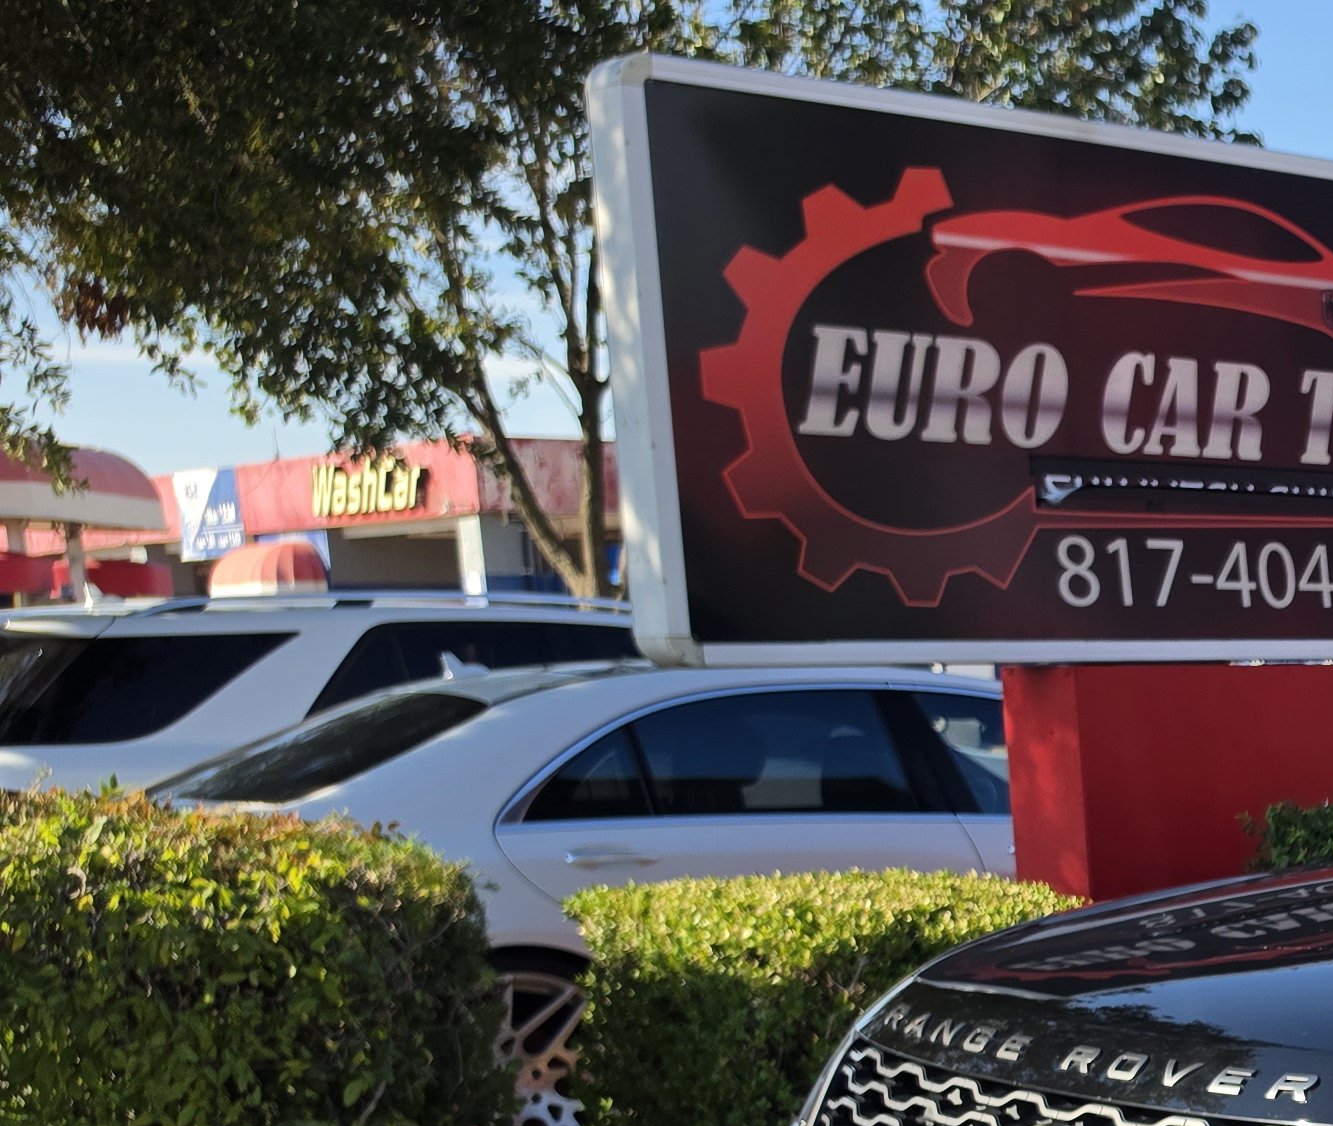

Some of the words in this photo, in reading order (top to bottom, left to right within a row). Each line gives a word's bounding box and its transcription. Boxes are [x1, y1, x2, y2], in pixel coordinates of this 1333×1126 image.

[800, 325, 1069, 449] EURO
[1101, 351, 1272, 462] CAR
[311, 456, 422, 518] WashCar
[883, 1004, 1034, 1062] RANGE
[1059, 1044, 1321, 1105] ROVER
